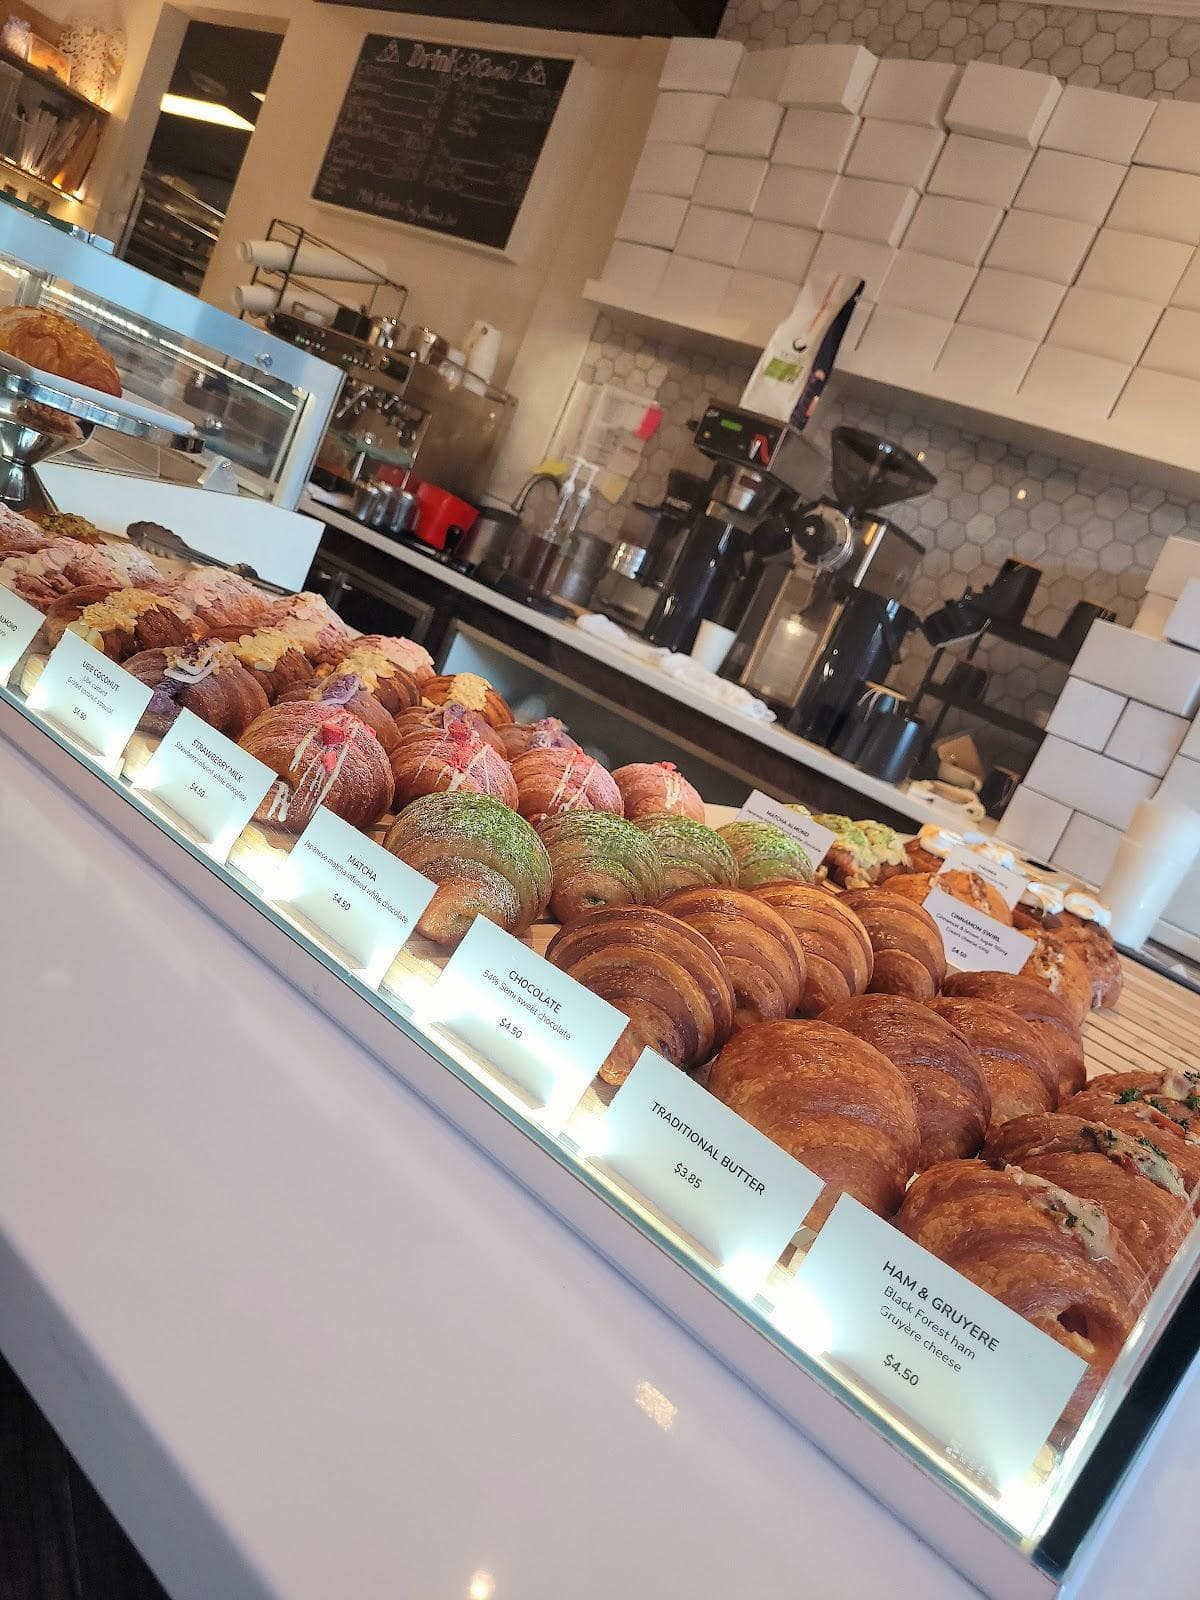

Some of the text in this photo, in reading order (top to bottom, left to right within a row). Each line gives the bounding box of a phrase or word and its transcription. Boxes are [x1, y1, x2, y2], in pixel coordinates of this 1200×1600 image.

[83, 661, 120, 691] UBE COCONUT
[174, 741, 247, 802] Strawberry infused white chocolate
[191, 739, 244, 783] STRAWBERRY MILK
[190, 782, 206, 798] $4.50
[766, 810, 787, 825] MATCHA
[787, 822, 810, 837] ALMOND
[304, 839, 409, 924] Japanese matcha infused white chocolate
[347, 854, 377, 882] MATCHA
[332, 893, 351, 911] $4.50
[951, 912, 1001, 942] CINNAMON SWIRL
[952, 946, 967, 959] $4.50
[482, 969, 571, 1041] 54% Semi sweet chocolate
[508, 970, 562, 1014] CHOCOLATE
[499, 1017, 523, 1039] $4.50
[651, 1101, 766, 1196] TRADITIONAL BUTTER
[673, 1162, 703, 1189] $3.85
[882, 1260, 1000, 1352] HAM & GRUYERE
[883, 1285, 976, 1360] Black Forest ham
[879, 1305, 962, 1373] Gruyère cheese
[883, 1353, 919, 1386] $4.50
